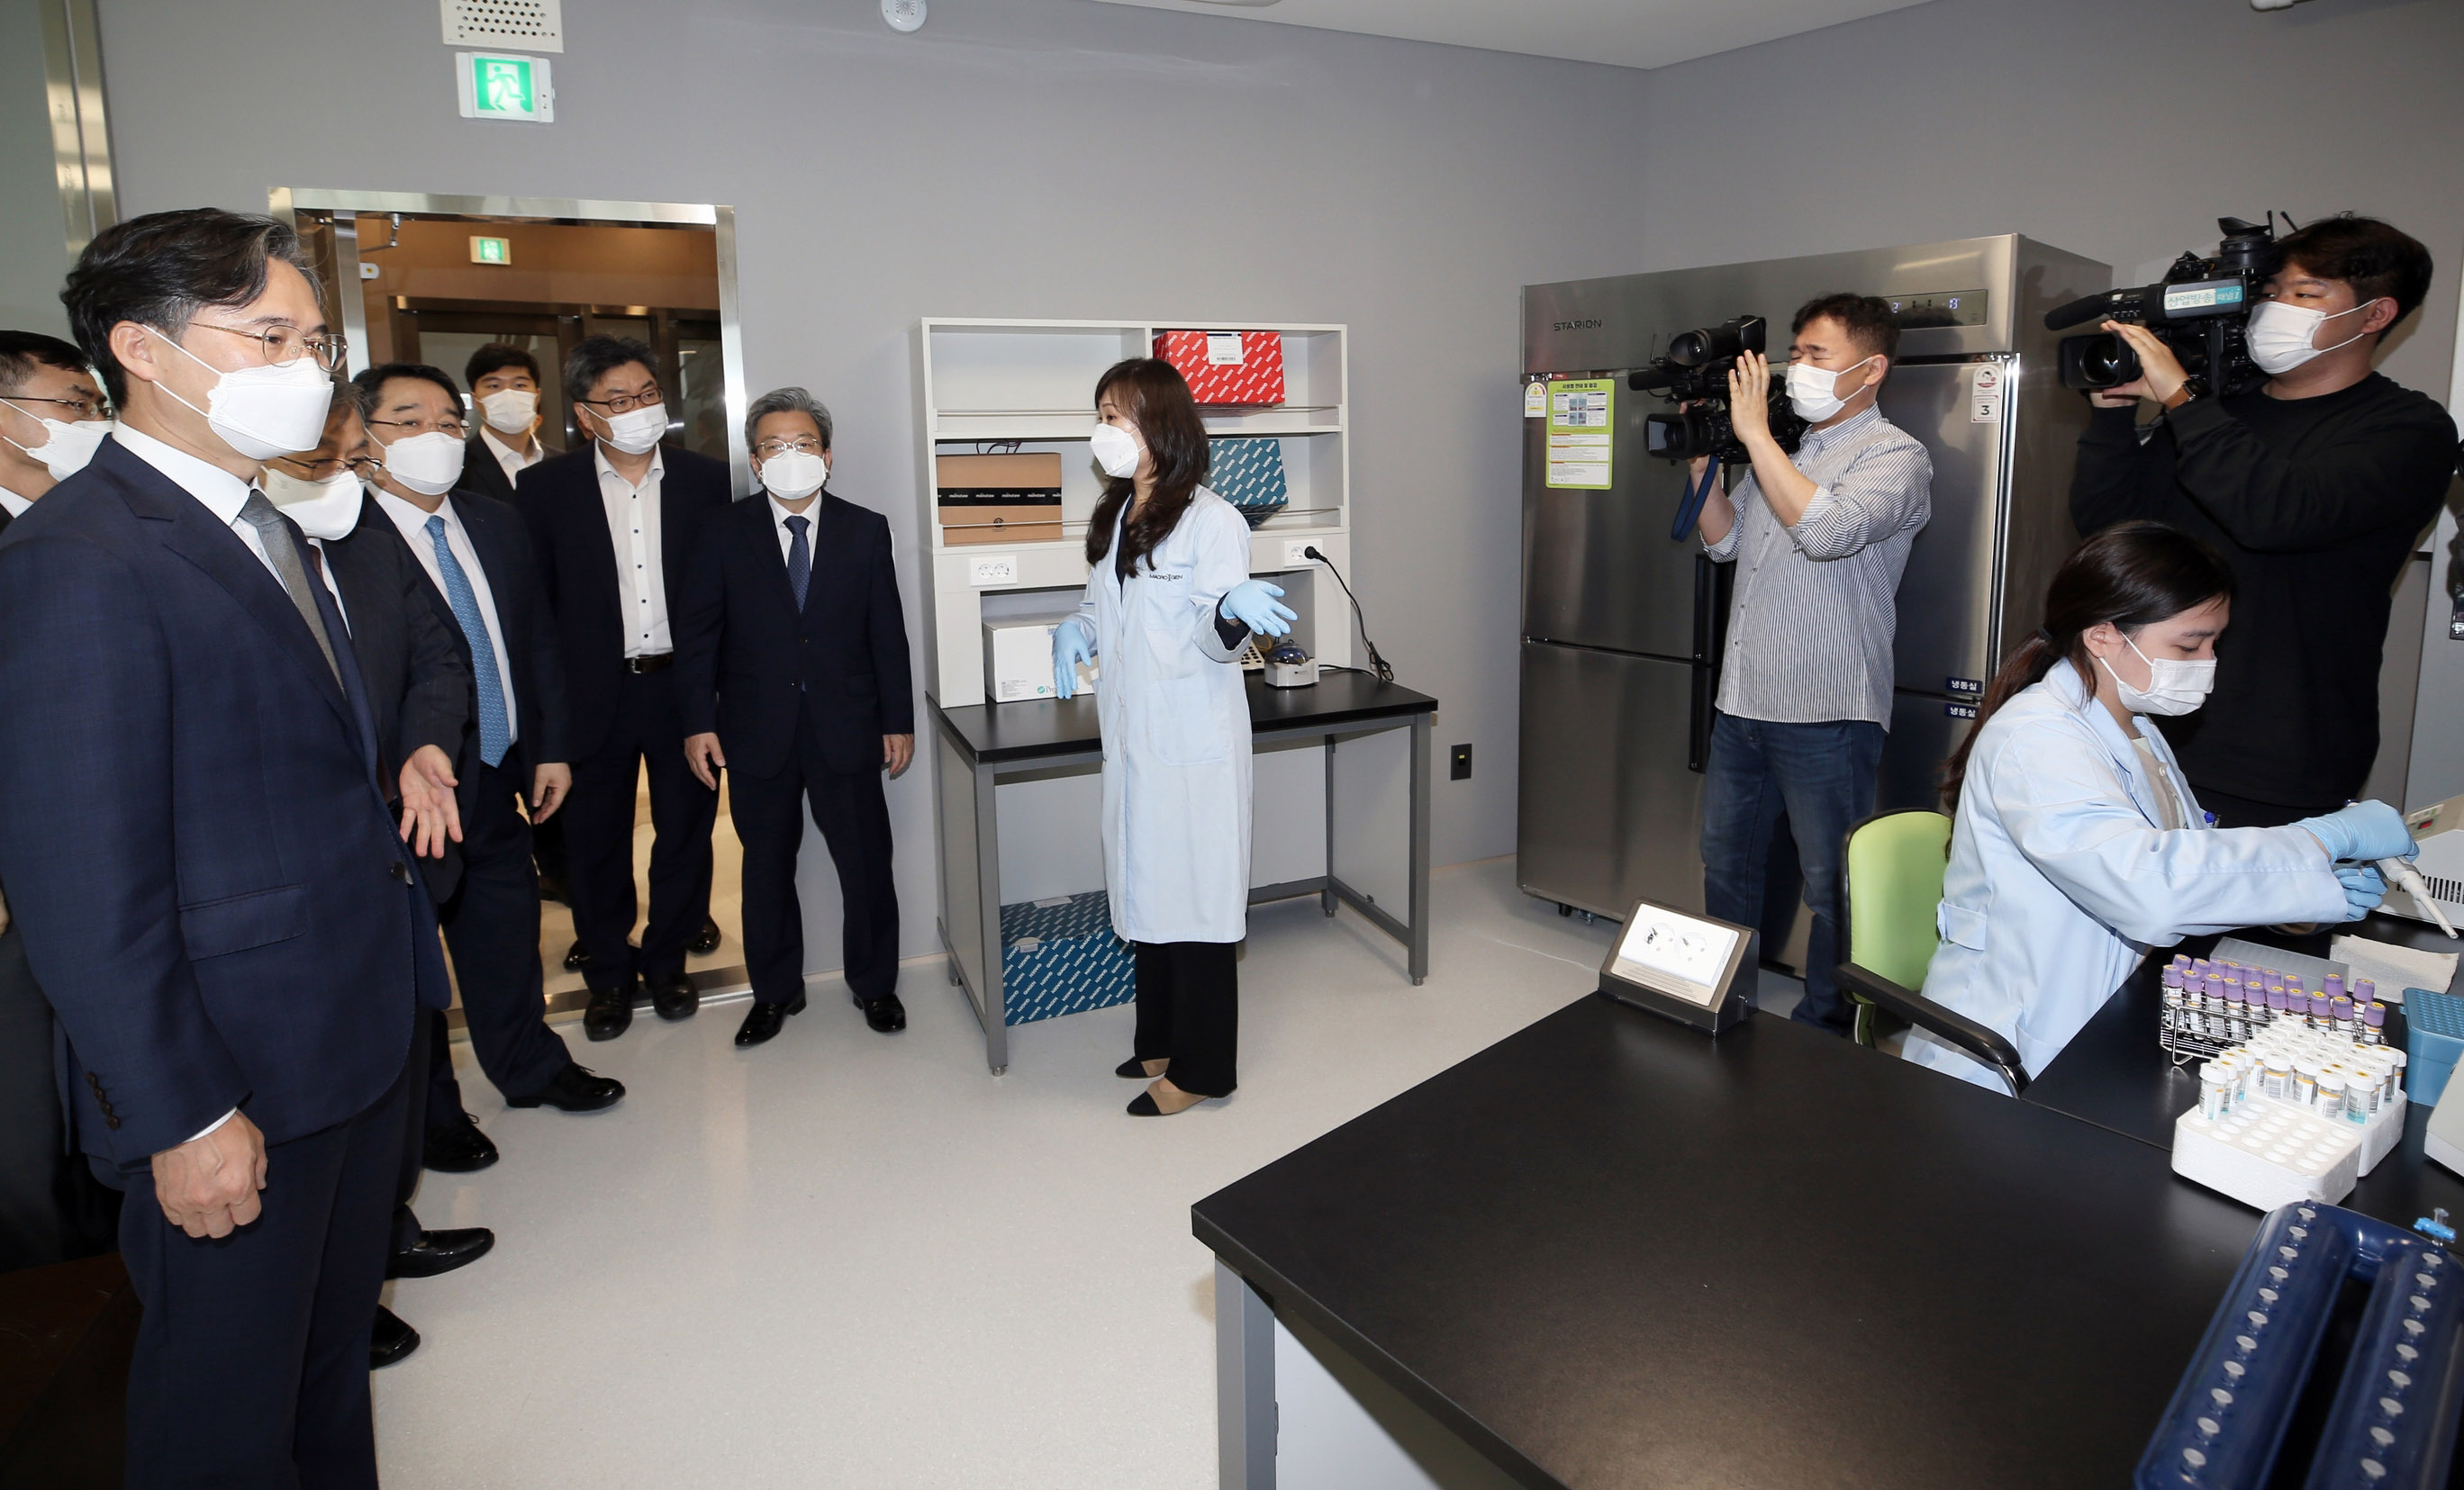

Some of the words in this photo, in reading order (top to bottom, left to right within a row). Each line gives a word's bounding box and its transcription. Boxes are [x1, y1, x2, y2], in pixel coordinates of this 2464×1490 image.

[2168, 293, 2213, 307] 산업방송
[1554, 320, 1602, 331] STARION
[1981, 406, 1989, 415] 3
[1952, 680, 1977, 691] 냉동실
[1950, 707, 1975, 718] 냉동실
[1080, 935, 1092, 949] QIAGEN
[1035, 946, 1047, 959] QIAGEN
[1063, 945, 1075, 958] QIAGEN
[1091, 944, 1102, 957] QIAGEN
[1018, 955, 1030, 968] QIAGEN
[1047, 954, 1058, 968] QIAGEN
[1074, 953, 1086, 966] QIAGEN
[1101, 952, 1113, 965] QIAGEN
[1029, 964, 1041, 977] QIAGEN
[1057, 963, 1069, 976] QIAGEN
[1085, 962, 1096, 974] QIAGEN
[1112, 960, 1123, 973] QIAGEN
[1012, 973, 1025, 986] QIAGEN
[1040, 972, 1053, 985] QIAGEN
[1068, 971, 1080, 984] QIAGEN
[1095, 970, 1107, 982] QIAGEN
[1122, 968, 1134, 981] QIAGEN
[1024, 981, 1036, 994] QIAGEN
[1051, 980, 1063, 993] QIAGEN
[1079, 979, 1091, 992] QIAGEN
[1106, 977, 1117, 990] QIAGEN
[1006, 991, 1018, 1004] QIAGEN
[1035, 989, 1047, 1002] QIAGEN
[1062, 988, 1074, 1001] QIAGEN
[1090, 987, 1101, 999] QIAGEN
[1116, 985, 1128, 998] QIAGEN
[1018, 999, 1030, 1012] QIAGEN
[1046, 997, 1058, 1010] QIAGEN
[1073, 996, 1085, 1008] QIAGEN
[1100, 994, 1112, 1007] QIAGEN
[1029, 1007, 1041, 1020] QIAGEN
